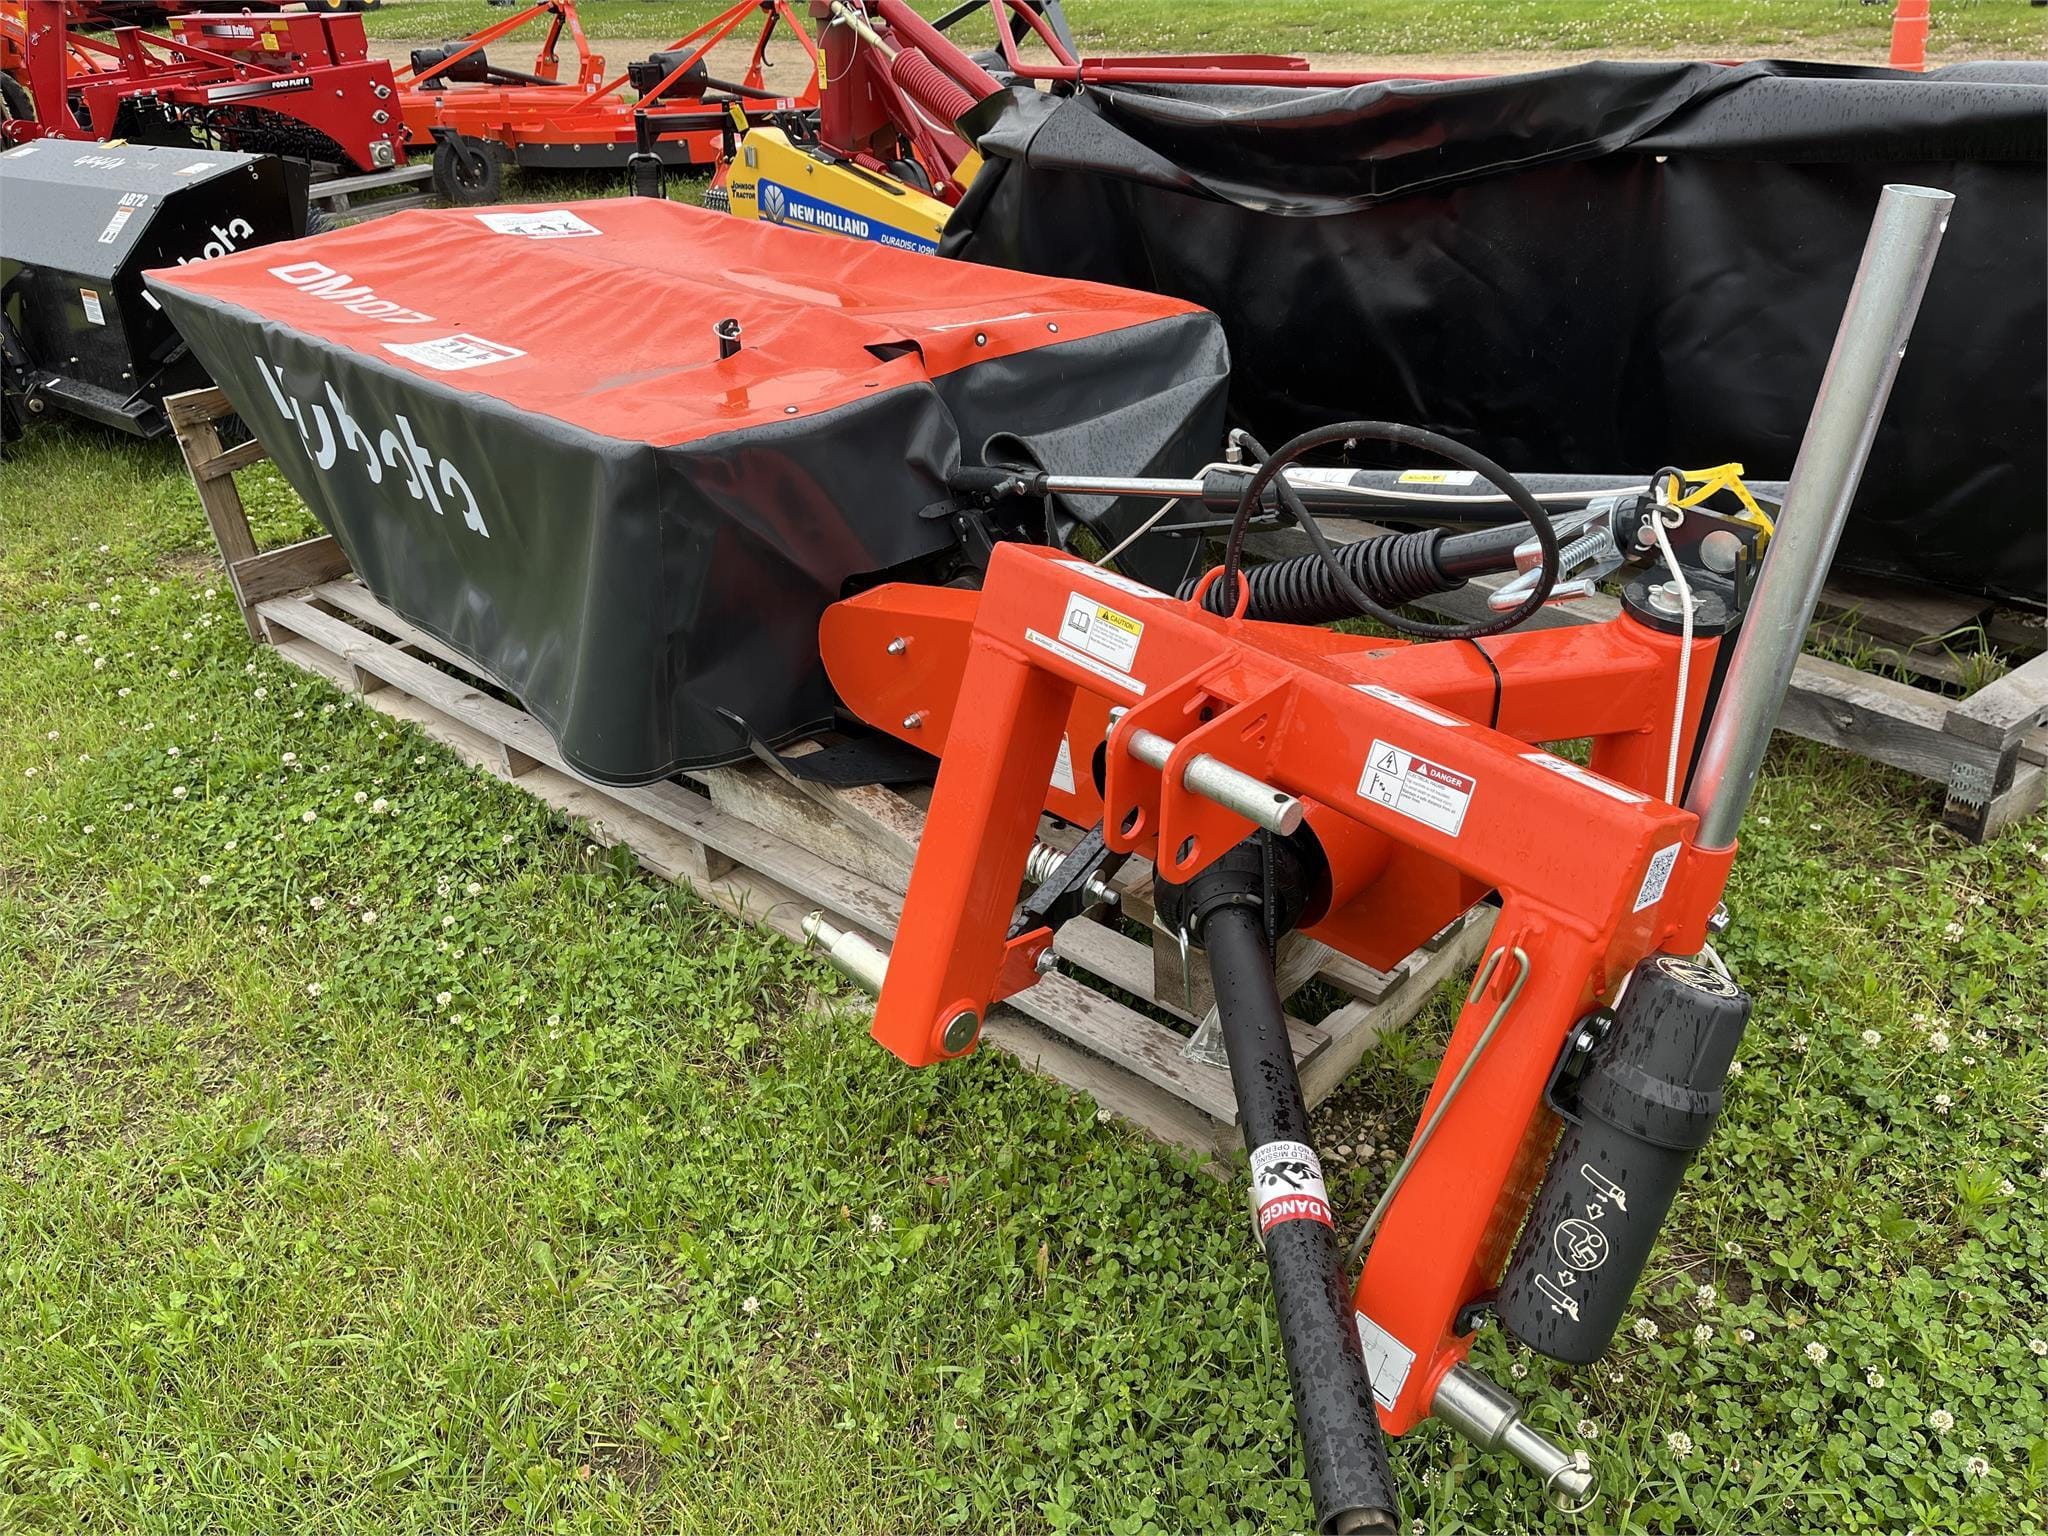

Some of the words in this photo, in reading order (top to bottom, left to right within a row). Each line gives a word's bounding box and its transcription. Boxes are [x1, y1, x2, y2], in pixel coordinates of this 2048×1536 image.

[271, 80, 289, 89] FOOD
[289, 78, 304, 87] PLOT
[117, 192, 149, 208] AB72
[789, 202, 815, 222] NEW
[816, 210, 870, 238] HOLLAND
[880, 234, 917, 252] DURADISC
[267, 260, 437, 324] DM1017
[1110, 615, 1135, 630] CAUTION
[1430, 768, 1463, 788] DANGER
[1255, 1143, 1290, 1158] OPERATE
[1256, 1151, 1289, 1167] MISSING
